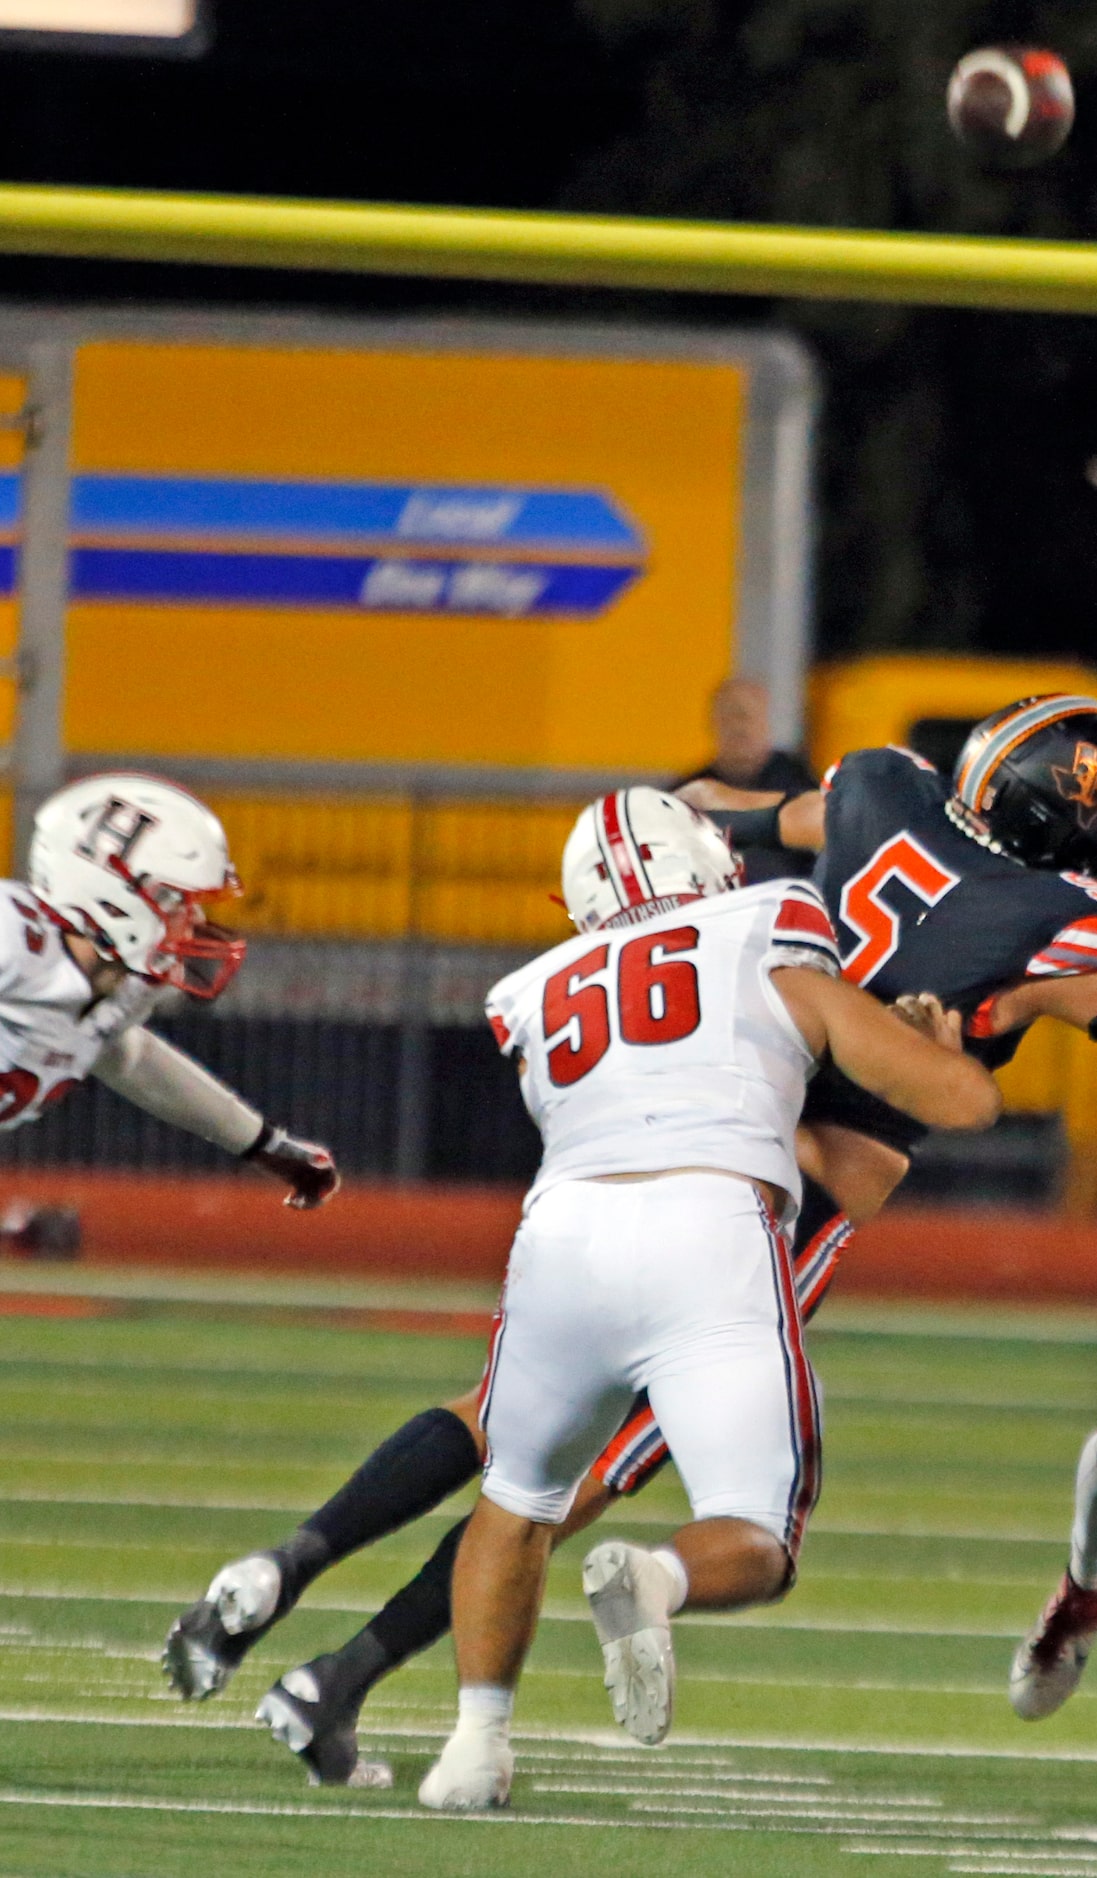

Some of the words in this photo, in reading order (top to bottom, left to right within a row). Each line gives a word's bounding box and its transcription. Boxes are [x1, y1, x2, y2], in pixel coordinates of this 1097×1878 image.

[73, 794, 161, 880] H
[839, 830, 961, 989] 5
[543, 925, 701, 1088] 56
